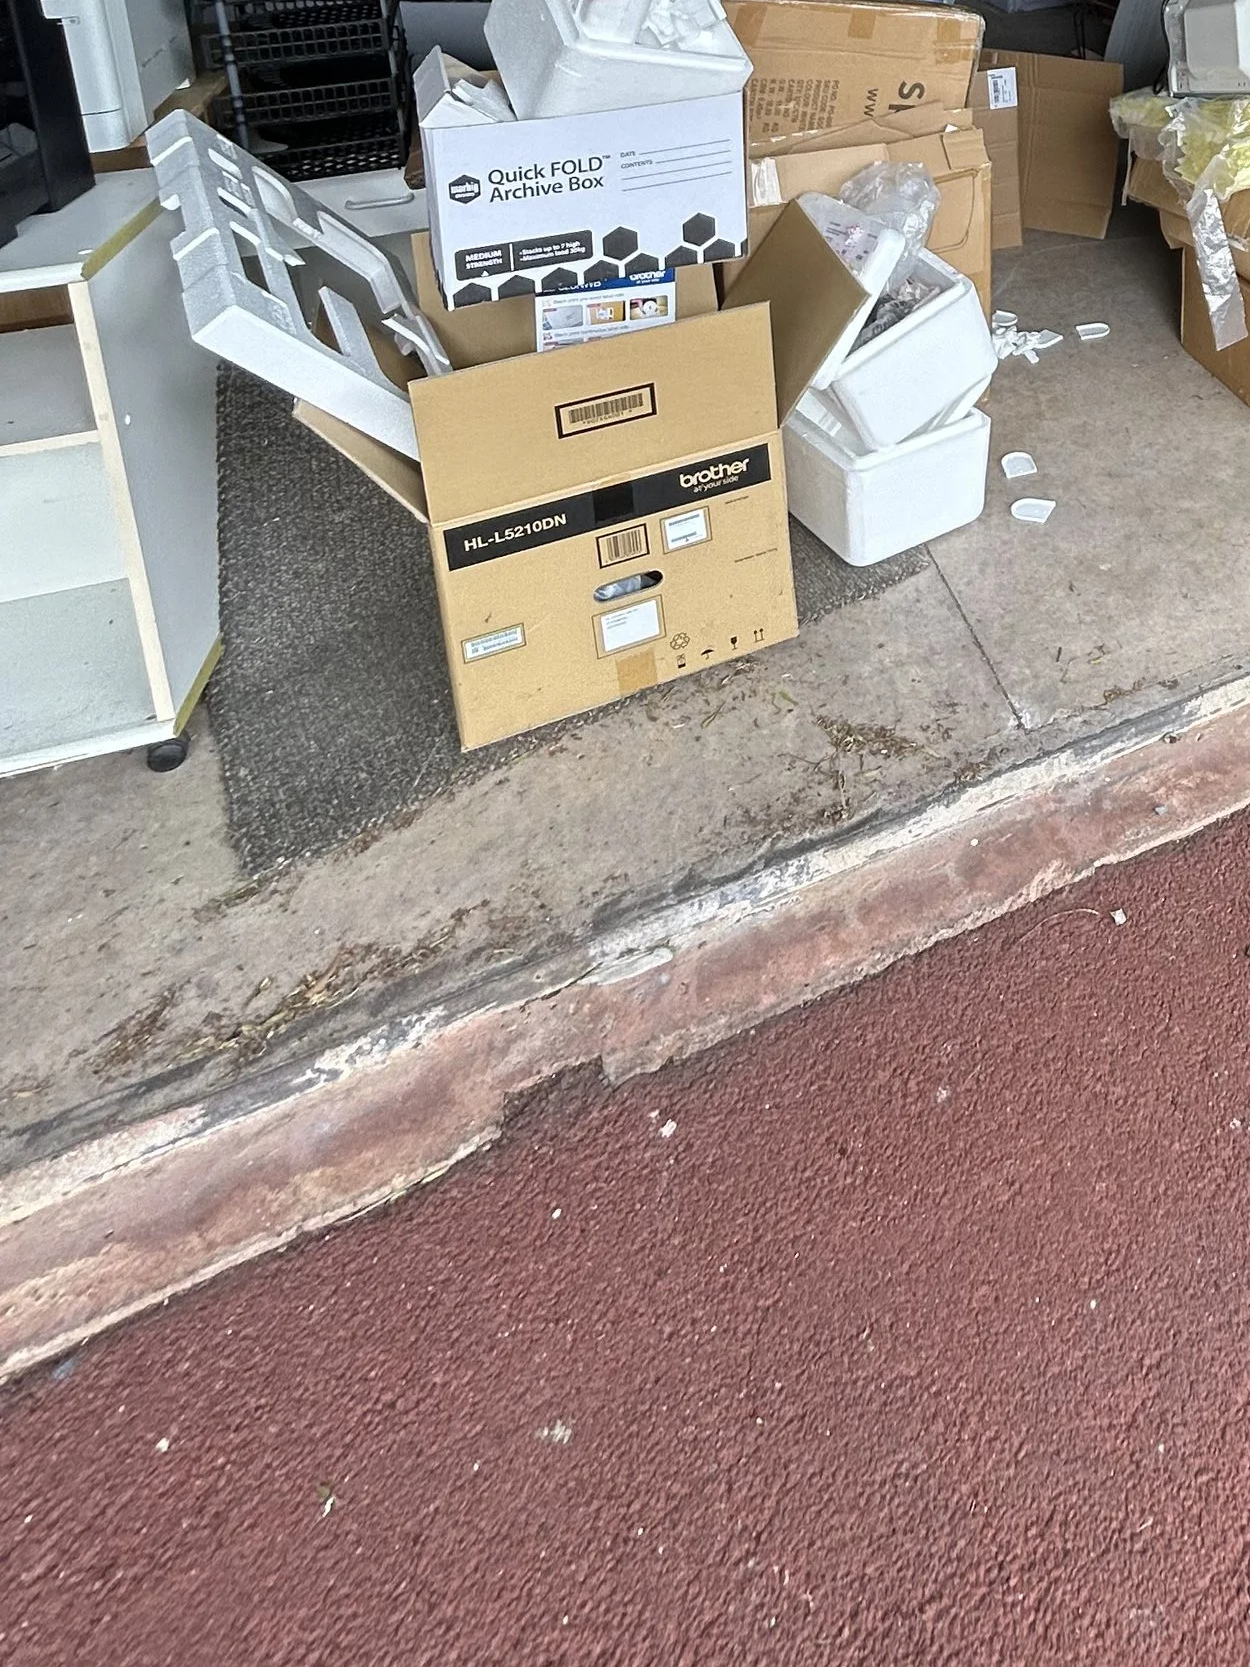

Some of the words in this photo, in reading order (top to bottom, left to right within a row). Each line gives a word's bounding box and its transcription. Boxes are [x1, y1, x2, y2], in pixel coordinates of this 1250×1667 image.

[488, 163, 545, 186] Quick
[620, 159, 653, 169] CONTENTS
[489, 181, 563, 203] Archive
[568, 175, 604, 192] Box
[465, 249, 502, 262] MEDIUM
[465, 258, 503, 269] STRENGTH
[679, 458, 750, 490] brother
[692, 482, 704, 493] at
[703, 477, 724, 492] your
[723, 474, 740, 485] side
[464, 512, 567, 552] HL-L5210DN
